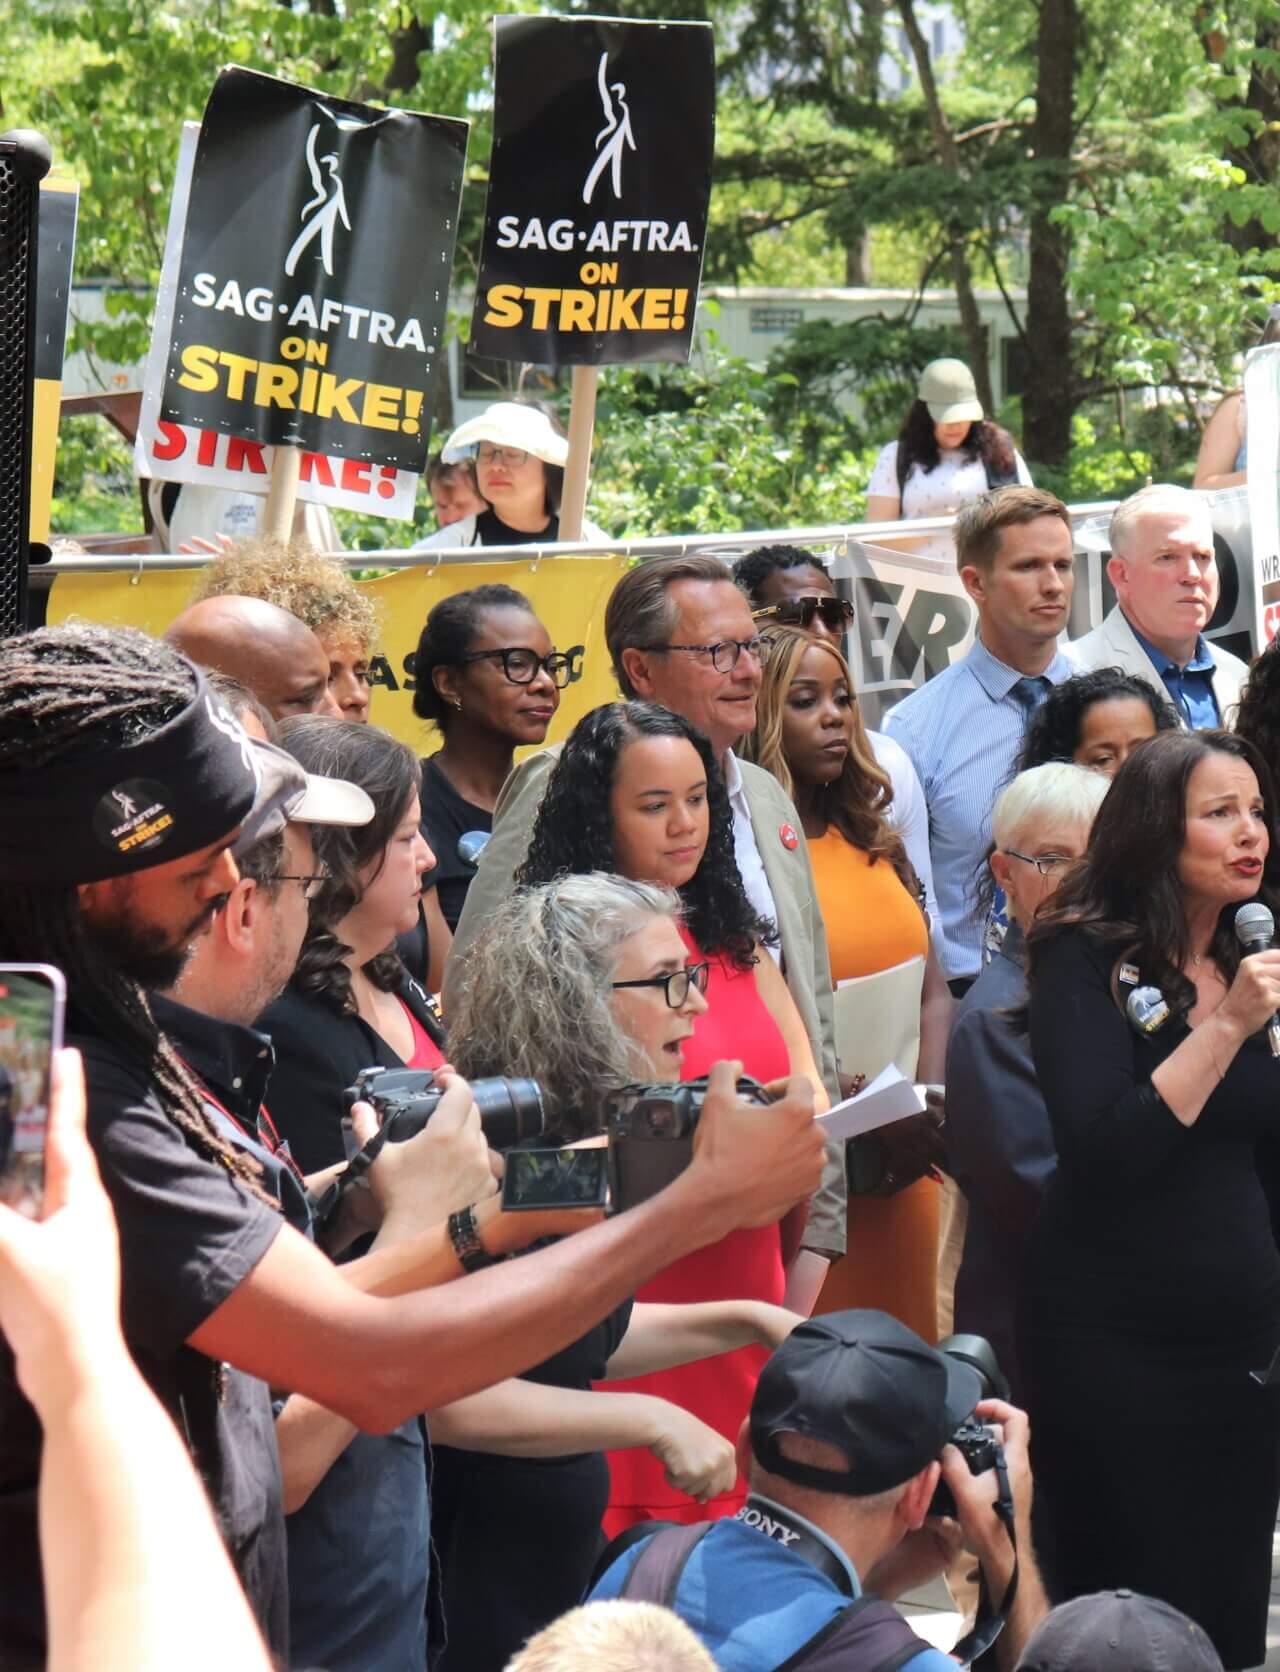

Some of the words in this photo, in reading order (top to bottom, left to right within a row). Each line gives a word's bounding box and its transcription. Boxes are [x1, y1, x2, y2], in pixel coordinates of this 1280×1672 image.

[579, 261, 619, 285] ON
[483, 284, 689, 332] STRIKE!
[280, 336, 328, 366] ON
[177, 344, 424, 435] STRIKE!
[734, 1506, 801, 1547] SONY
